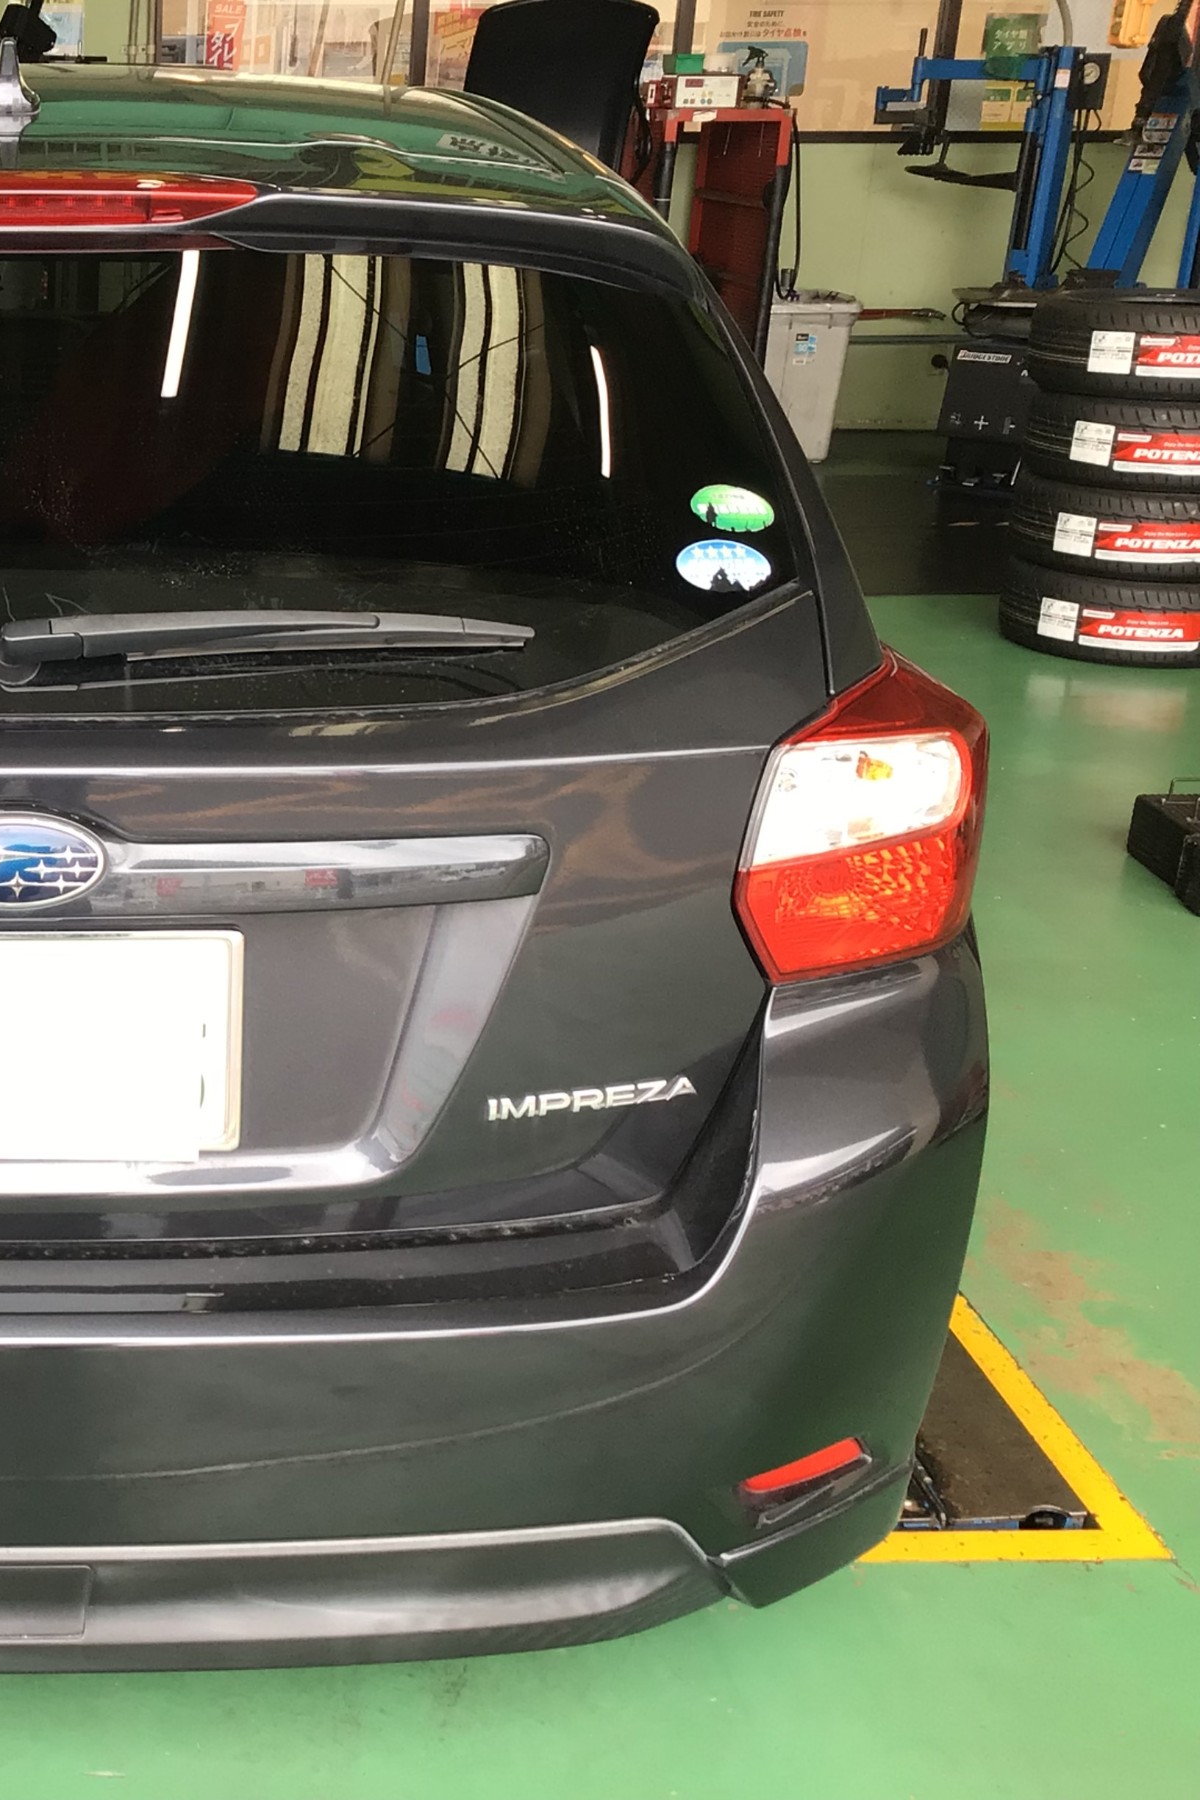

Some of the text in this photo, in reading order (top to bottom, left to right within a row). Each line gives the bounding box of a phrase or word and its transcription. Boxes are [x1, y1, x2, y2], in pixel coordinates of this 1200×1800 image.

[214, 4, 243, 14] SALE
[958, 350, 1011, 363] BRIDGESTONE
[1133, 448, 1200, 461] POTEN
[1115, 538, 1200, 549] POTENZA
[1098, 625, 1184, 638] POTENZA
[488, 1076, 697, 1121] IMPREZA
